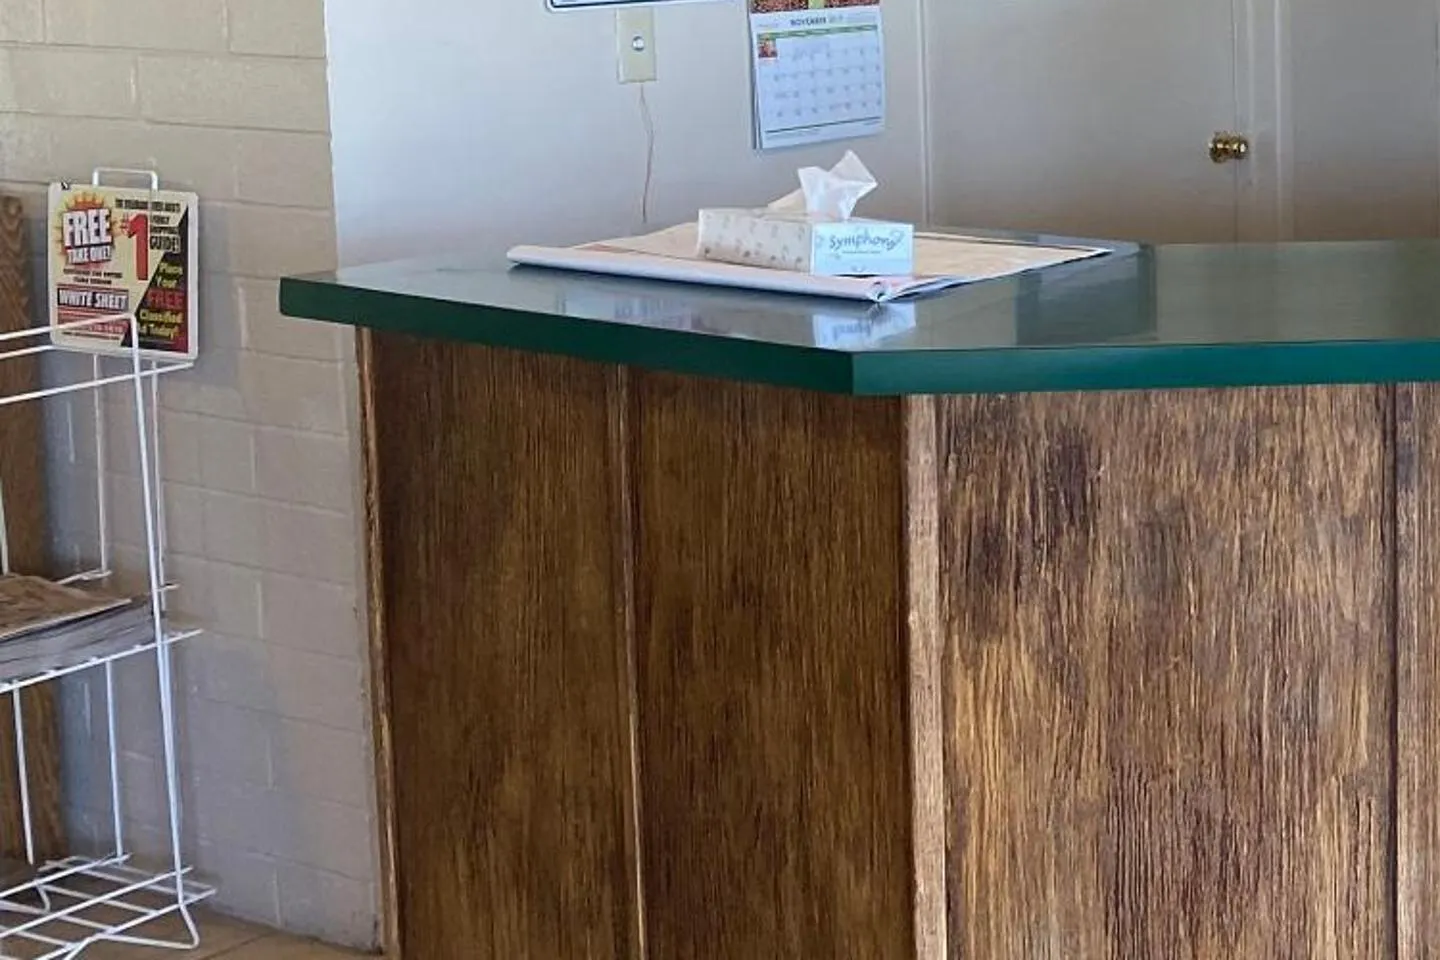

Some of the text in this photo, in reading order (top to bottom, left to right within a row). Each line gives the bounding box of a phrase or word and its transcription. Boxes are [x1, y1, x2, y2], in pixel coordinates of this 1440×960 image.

[63, 209, 112, 246] FREE
[829, 229, 899, 251] Symphony
[95, 291, 129, 311] SHEET
